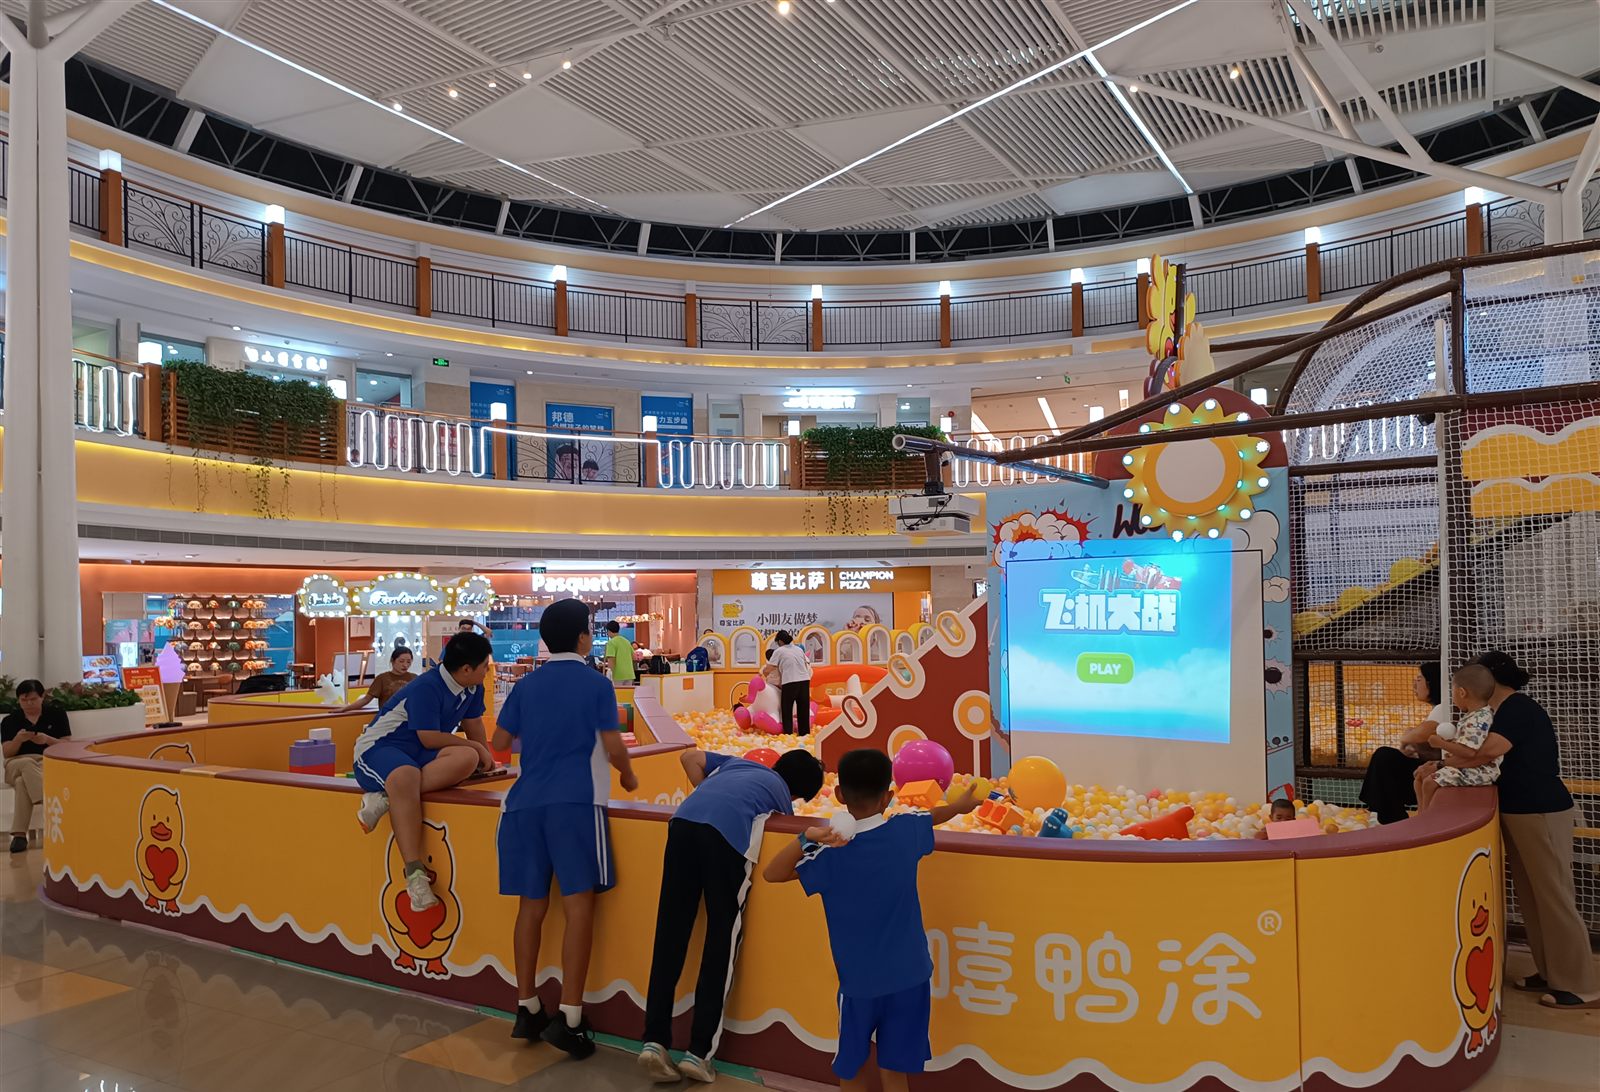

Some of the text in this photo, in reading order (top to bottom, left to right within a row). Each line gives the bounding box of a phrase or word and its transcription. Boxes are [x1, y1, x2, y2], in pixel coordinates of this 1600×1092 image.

[751, 571, 825, 591] 尊宝比萨
[839, 571, 894, 580] CHAMPION
[531, 573, 630, 596] Pasquetta
[840, 581, 870, 590] PIZZA
[757, 612, 818, 626] 小朋友做梦
[1042, 592, 1178, 633] 飞机大战
[1089, 662, 1122, 676] PLAY
